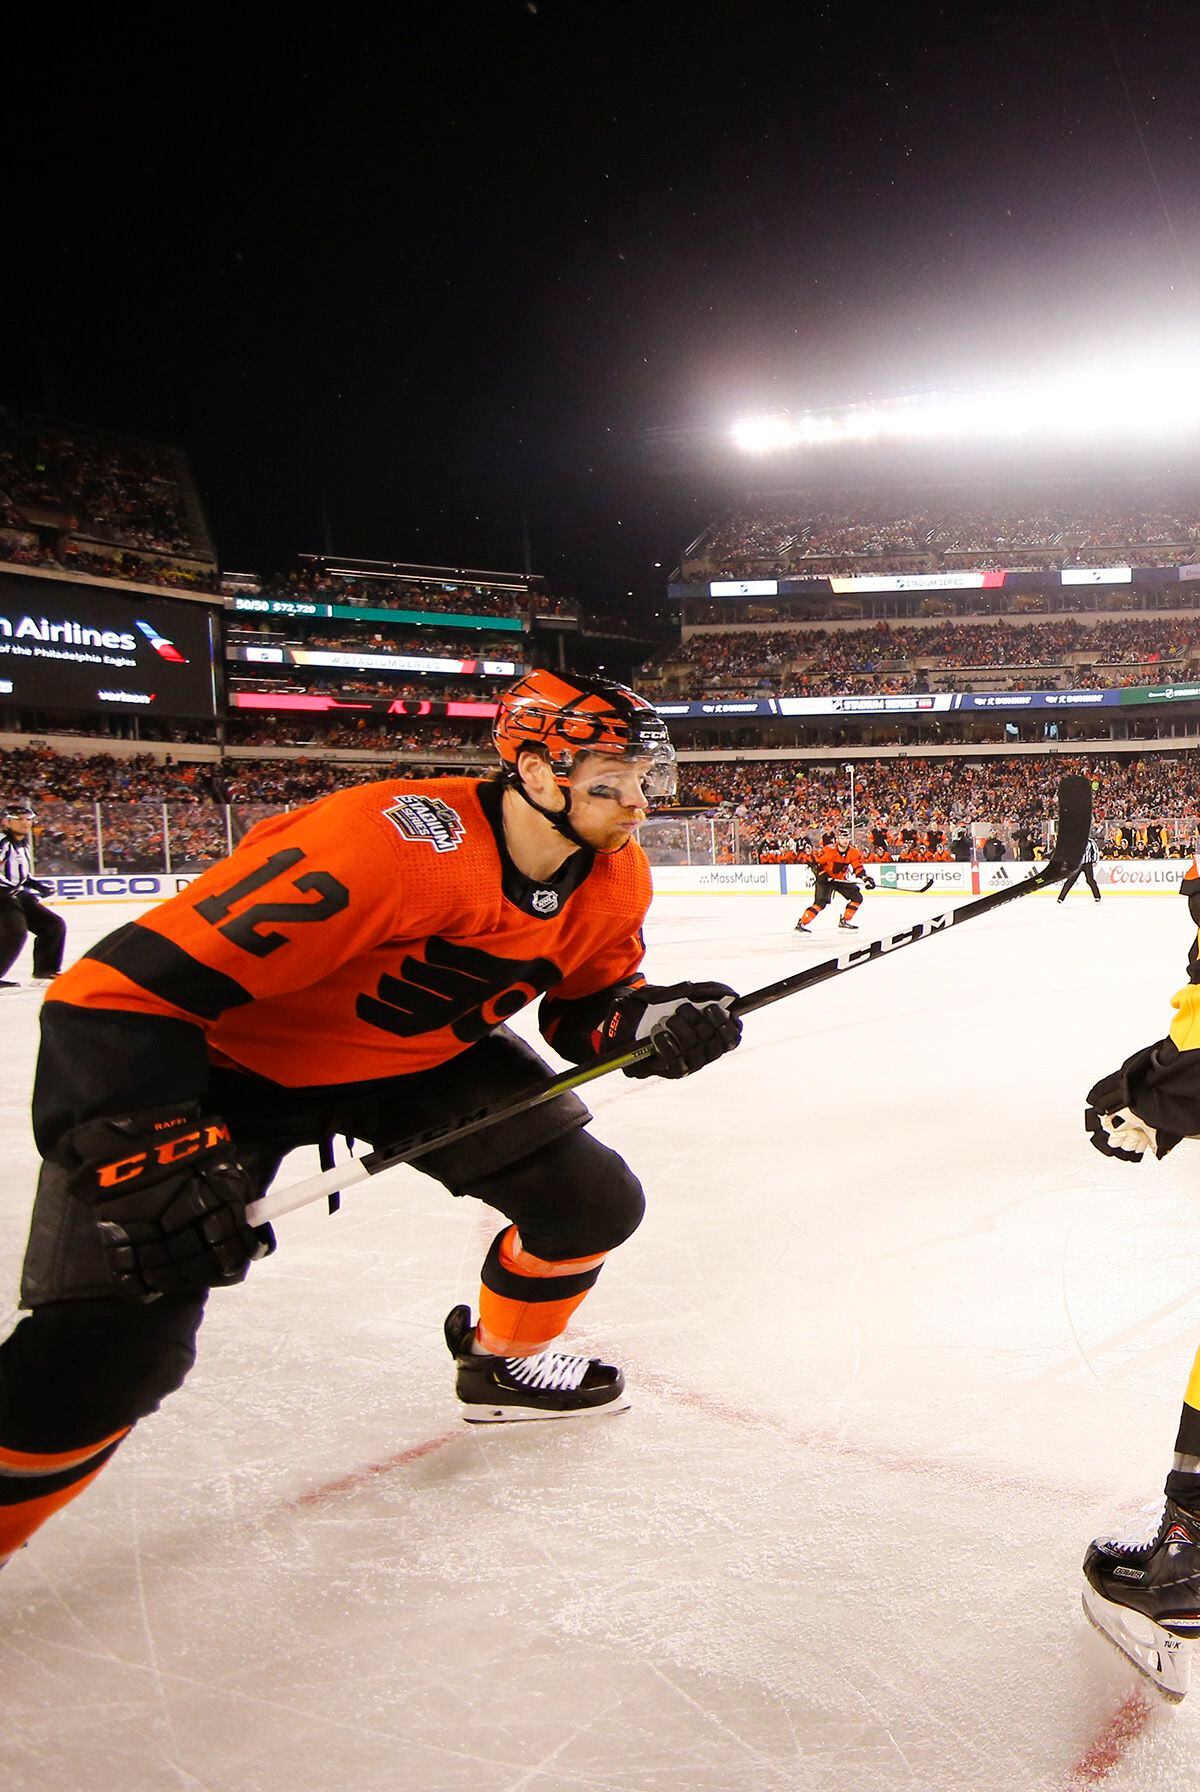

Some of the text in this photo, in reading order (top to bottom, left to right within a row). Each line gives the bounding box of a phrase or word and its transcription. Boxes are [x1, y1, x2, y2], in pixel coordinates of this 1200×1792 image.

[15, 616, 137, 651] Airlines
[35, 648, 102, 664] Philadelphia
[401, 796, 455, 849] STADIUM
[402, 808, 430, 836] SERIES
[711, 872, 768, 884] MassMutual
[885, 868, 962, 886] enterprise
[989, 879, 1014, 887] adidas
[1110, 865, 1184, 884] Coors LIGH
[193, 848, 349, 958] 12
[837, 909, 955, 971] CCM
[608, 1011, 622, 1039] CCM
[154, 1117, 187, 1131] RAFFI
[96, 1122, 232, 1188] CCM
